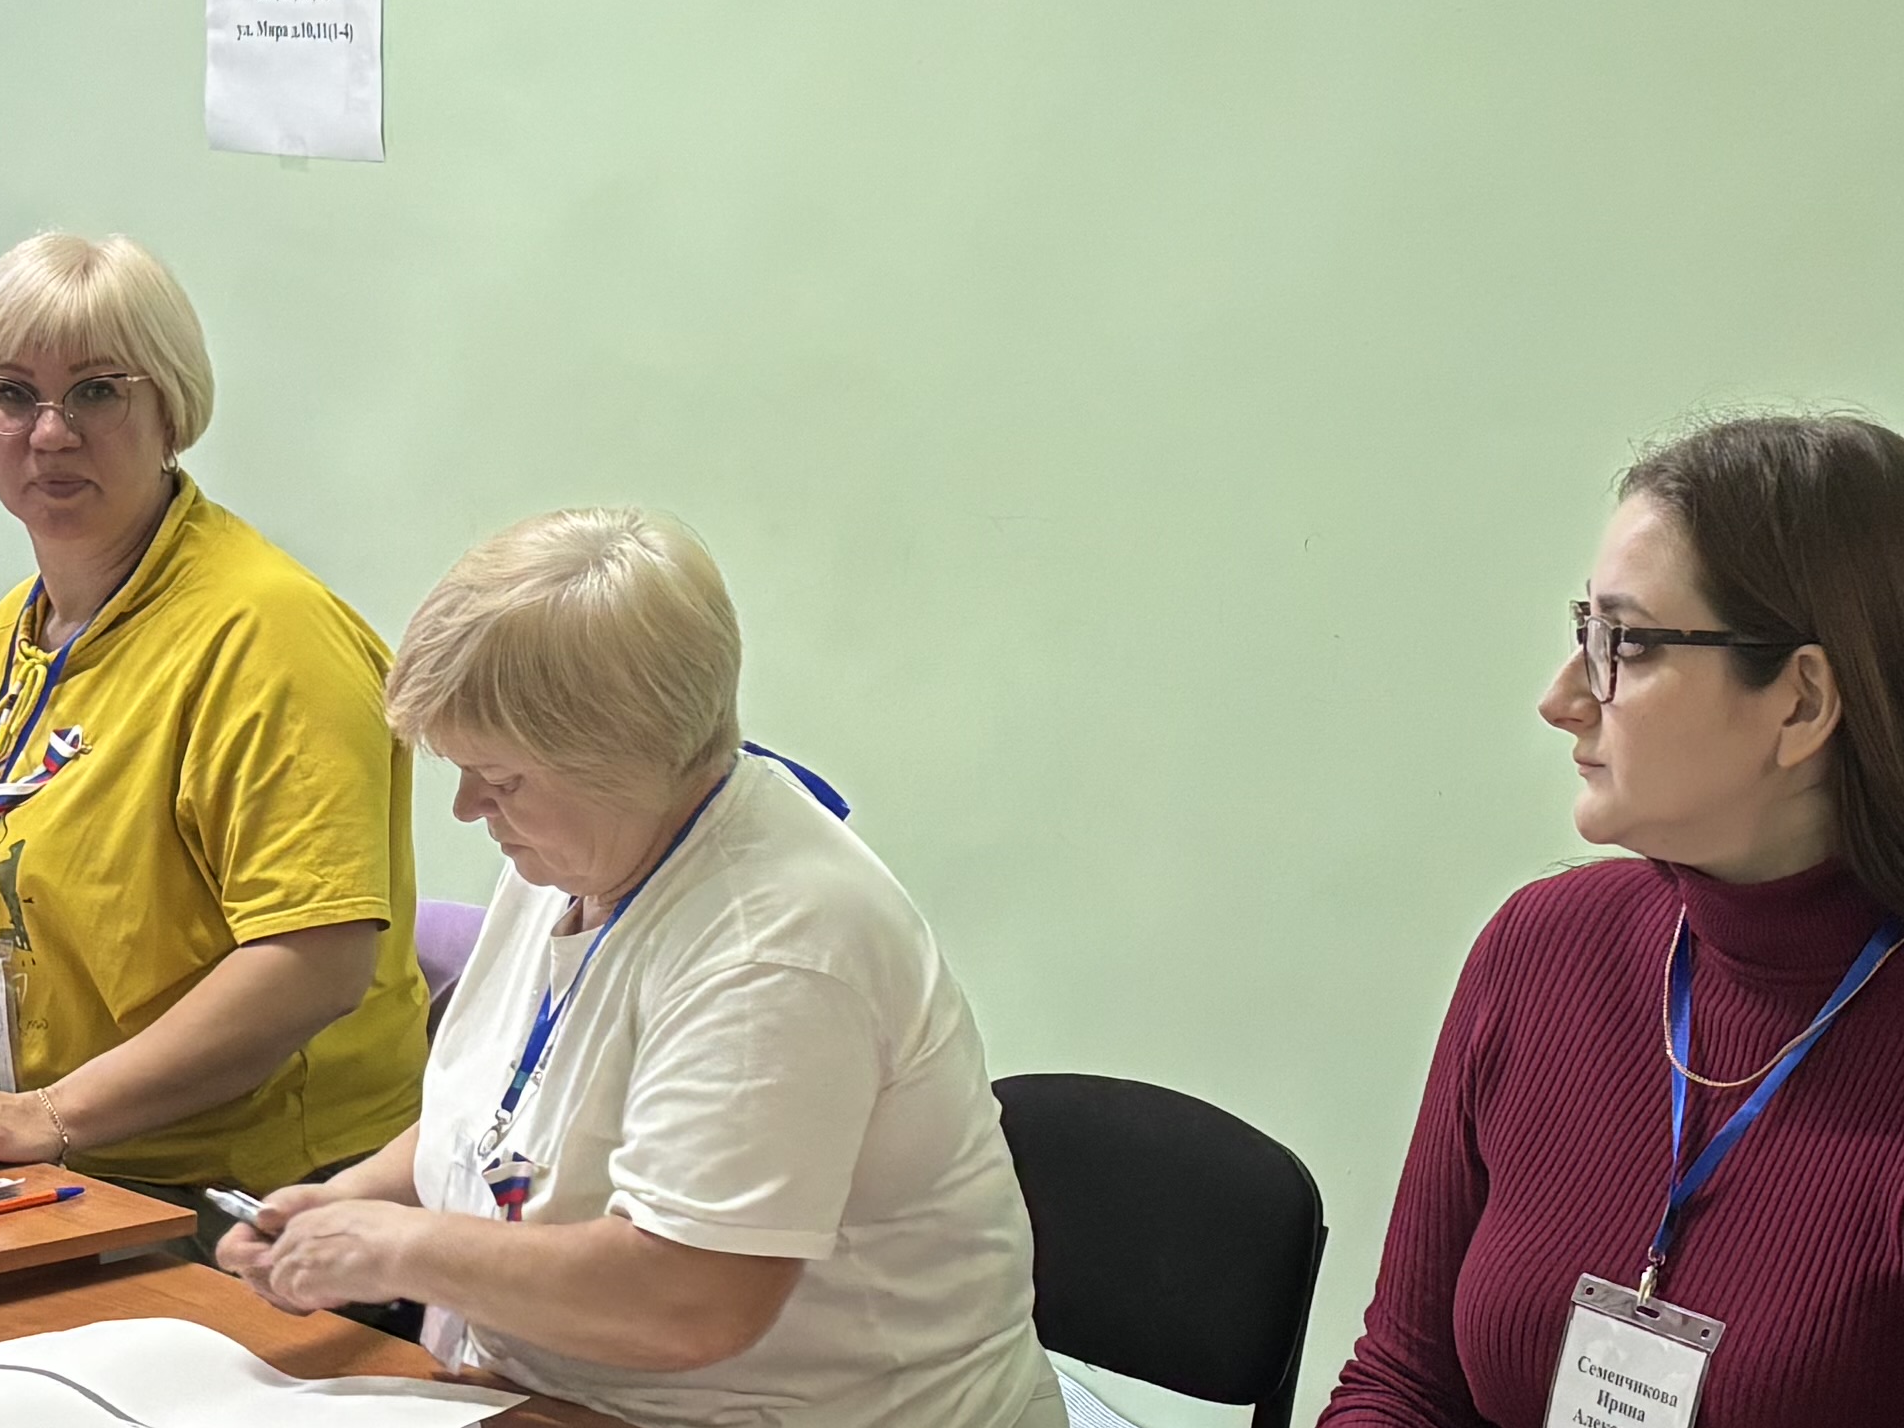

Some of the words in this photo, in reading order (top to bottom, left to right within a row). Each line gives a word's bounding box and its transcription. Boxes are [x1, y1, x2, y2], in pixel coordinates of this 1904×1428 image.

[237, 25, 253, 40] ул.
[257, 21, 288, 42] Мира
[1578, 1355, 1678, 1407] Семенчикова
[1597, 1389, 1645, 1422] Ирина
